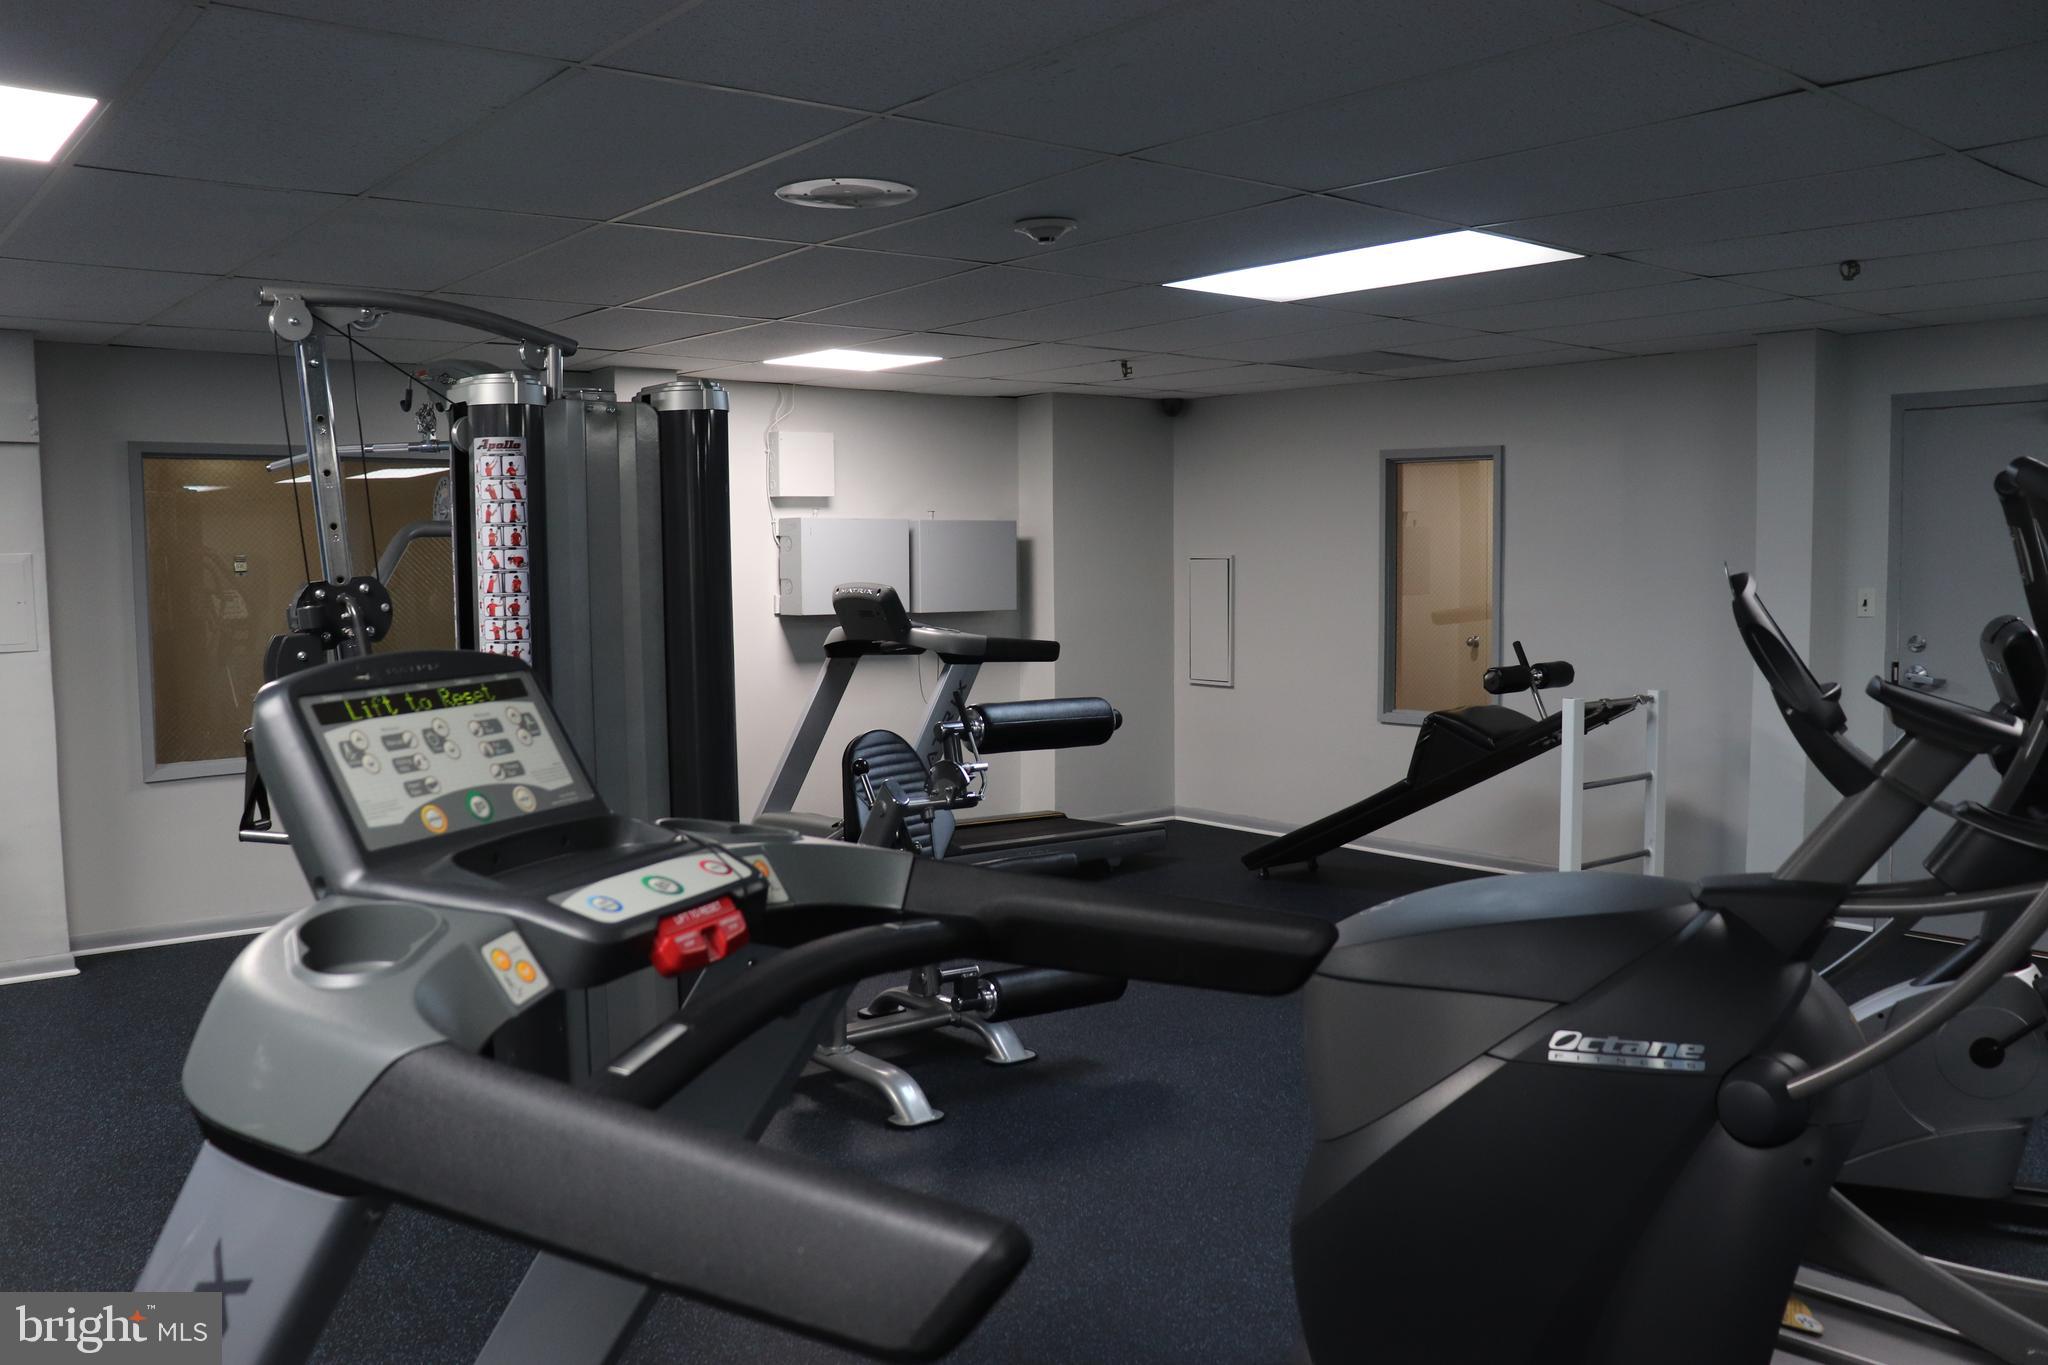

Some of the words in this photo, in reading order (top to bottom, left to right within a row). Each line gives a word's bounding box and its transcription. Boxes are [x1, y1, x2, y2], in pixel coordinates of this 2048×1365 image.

[477, 439, 521, 451] Apollo
[344, 694, 399, 721] Lift
[405, 692, 433, 711] to
[437, 684, 496, 707] Reset
[1548, 1029, 1705, 1059] Octane
[1552, 1052, 1699, 1070] FITNESS
